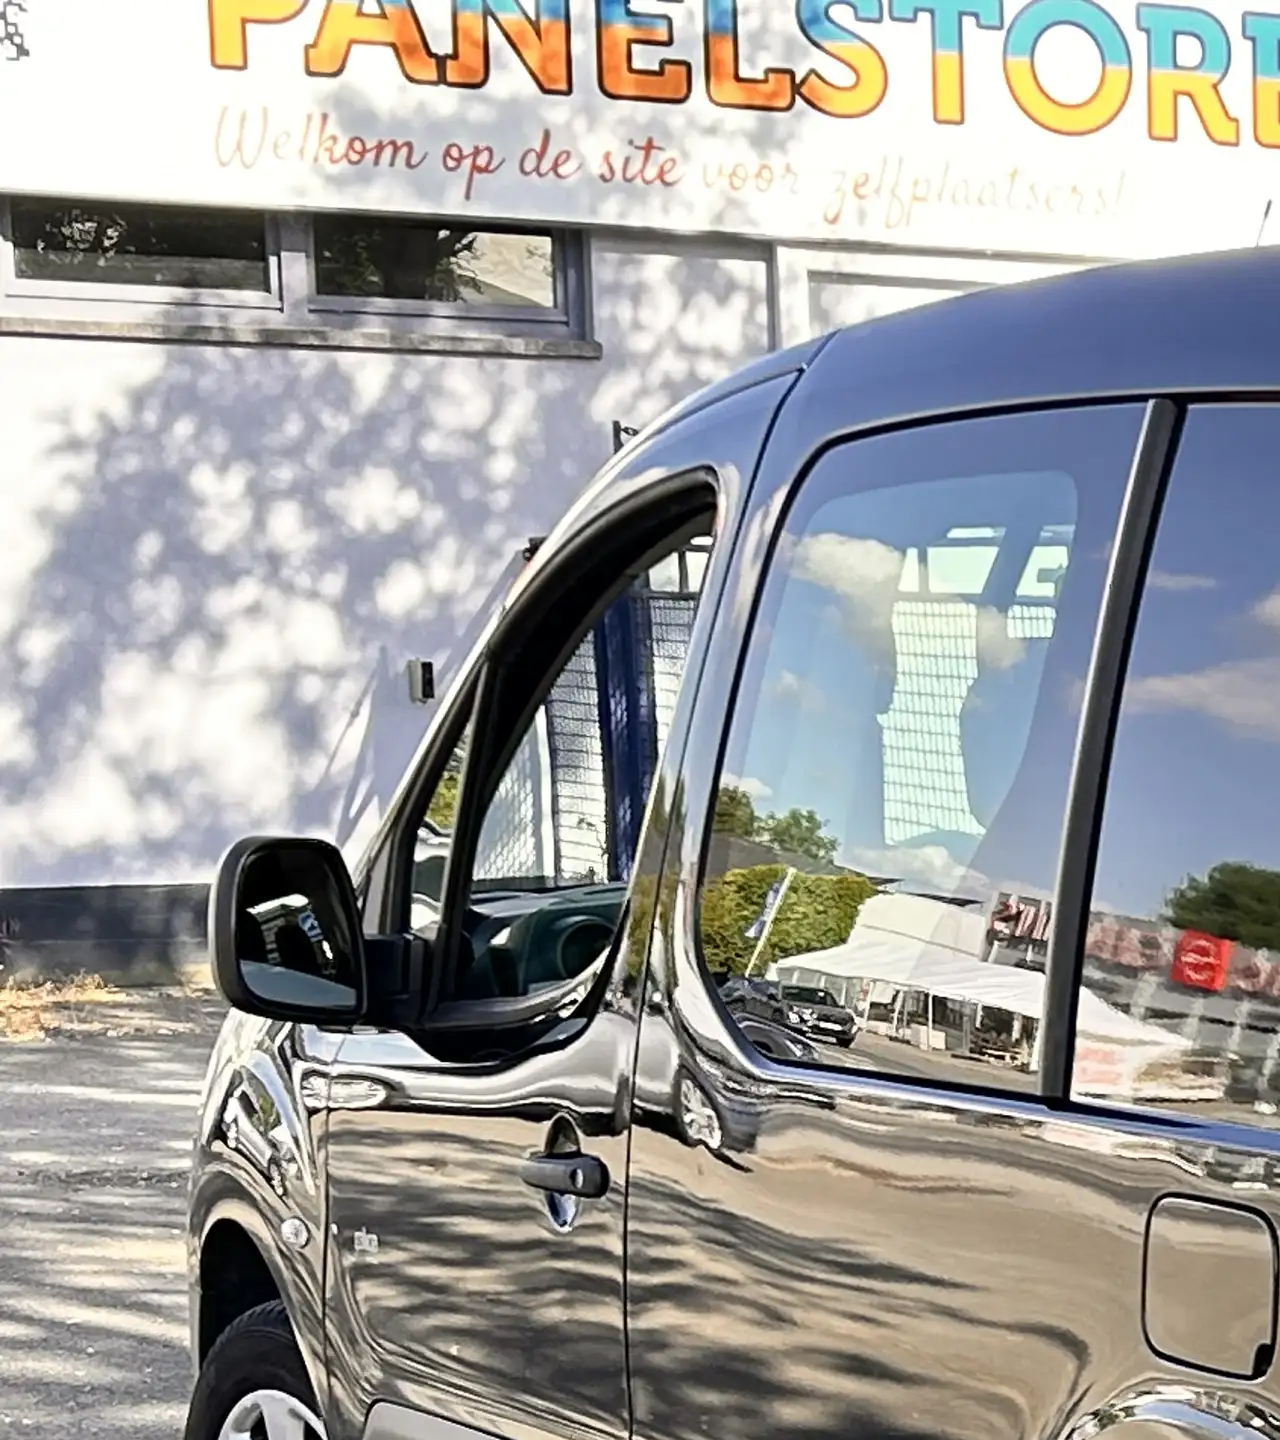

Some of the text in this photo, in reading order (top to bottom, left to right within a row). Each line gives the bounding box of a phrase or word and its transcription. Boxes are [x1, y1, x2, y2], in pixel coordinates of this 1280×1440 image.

[214, 105, 428, 170] Welkom
[442, 141, 505, 201] op
[519, 128, 582, 179] de
[600, 136, 686, 187] site
[702, 162, 798, 195] voor
